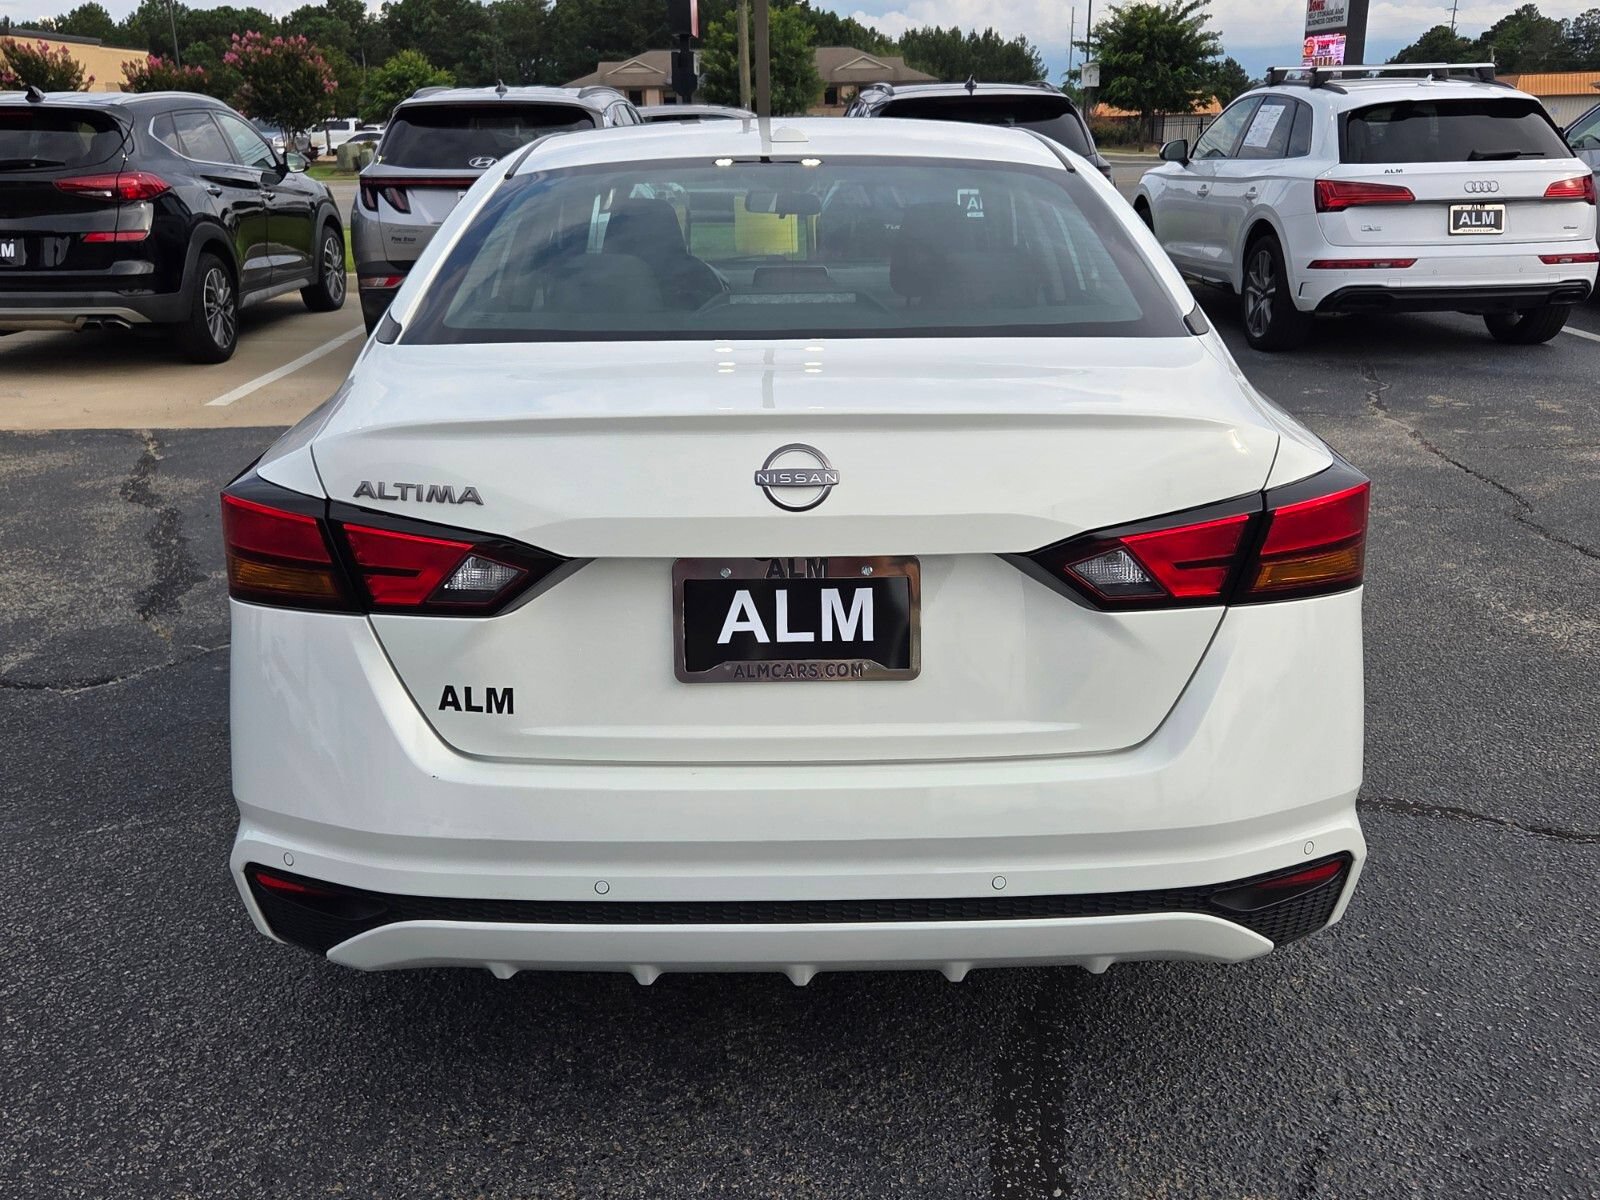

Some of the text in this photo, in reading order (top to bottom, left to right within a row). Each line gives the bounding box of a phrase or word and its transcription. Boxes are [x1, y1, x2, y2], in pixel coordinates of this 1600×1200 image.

[1326, 15, 1344, 24] CENTERS
[1335, 7, 1345, 15] AND
[1458, 211, 1495, 225] ALM
[757, 473, 837, 483] NISSAN
[353, 480, 485, 506] ALTIMA
[765, 557, 829, 579] ALM
[716, 587, 874, 644] ALM
[733, 662, 865, 679] ALMCARS.COM
[438, 684, 514, 715] ALM
